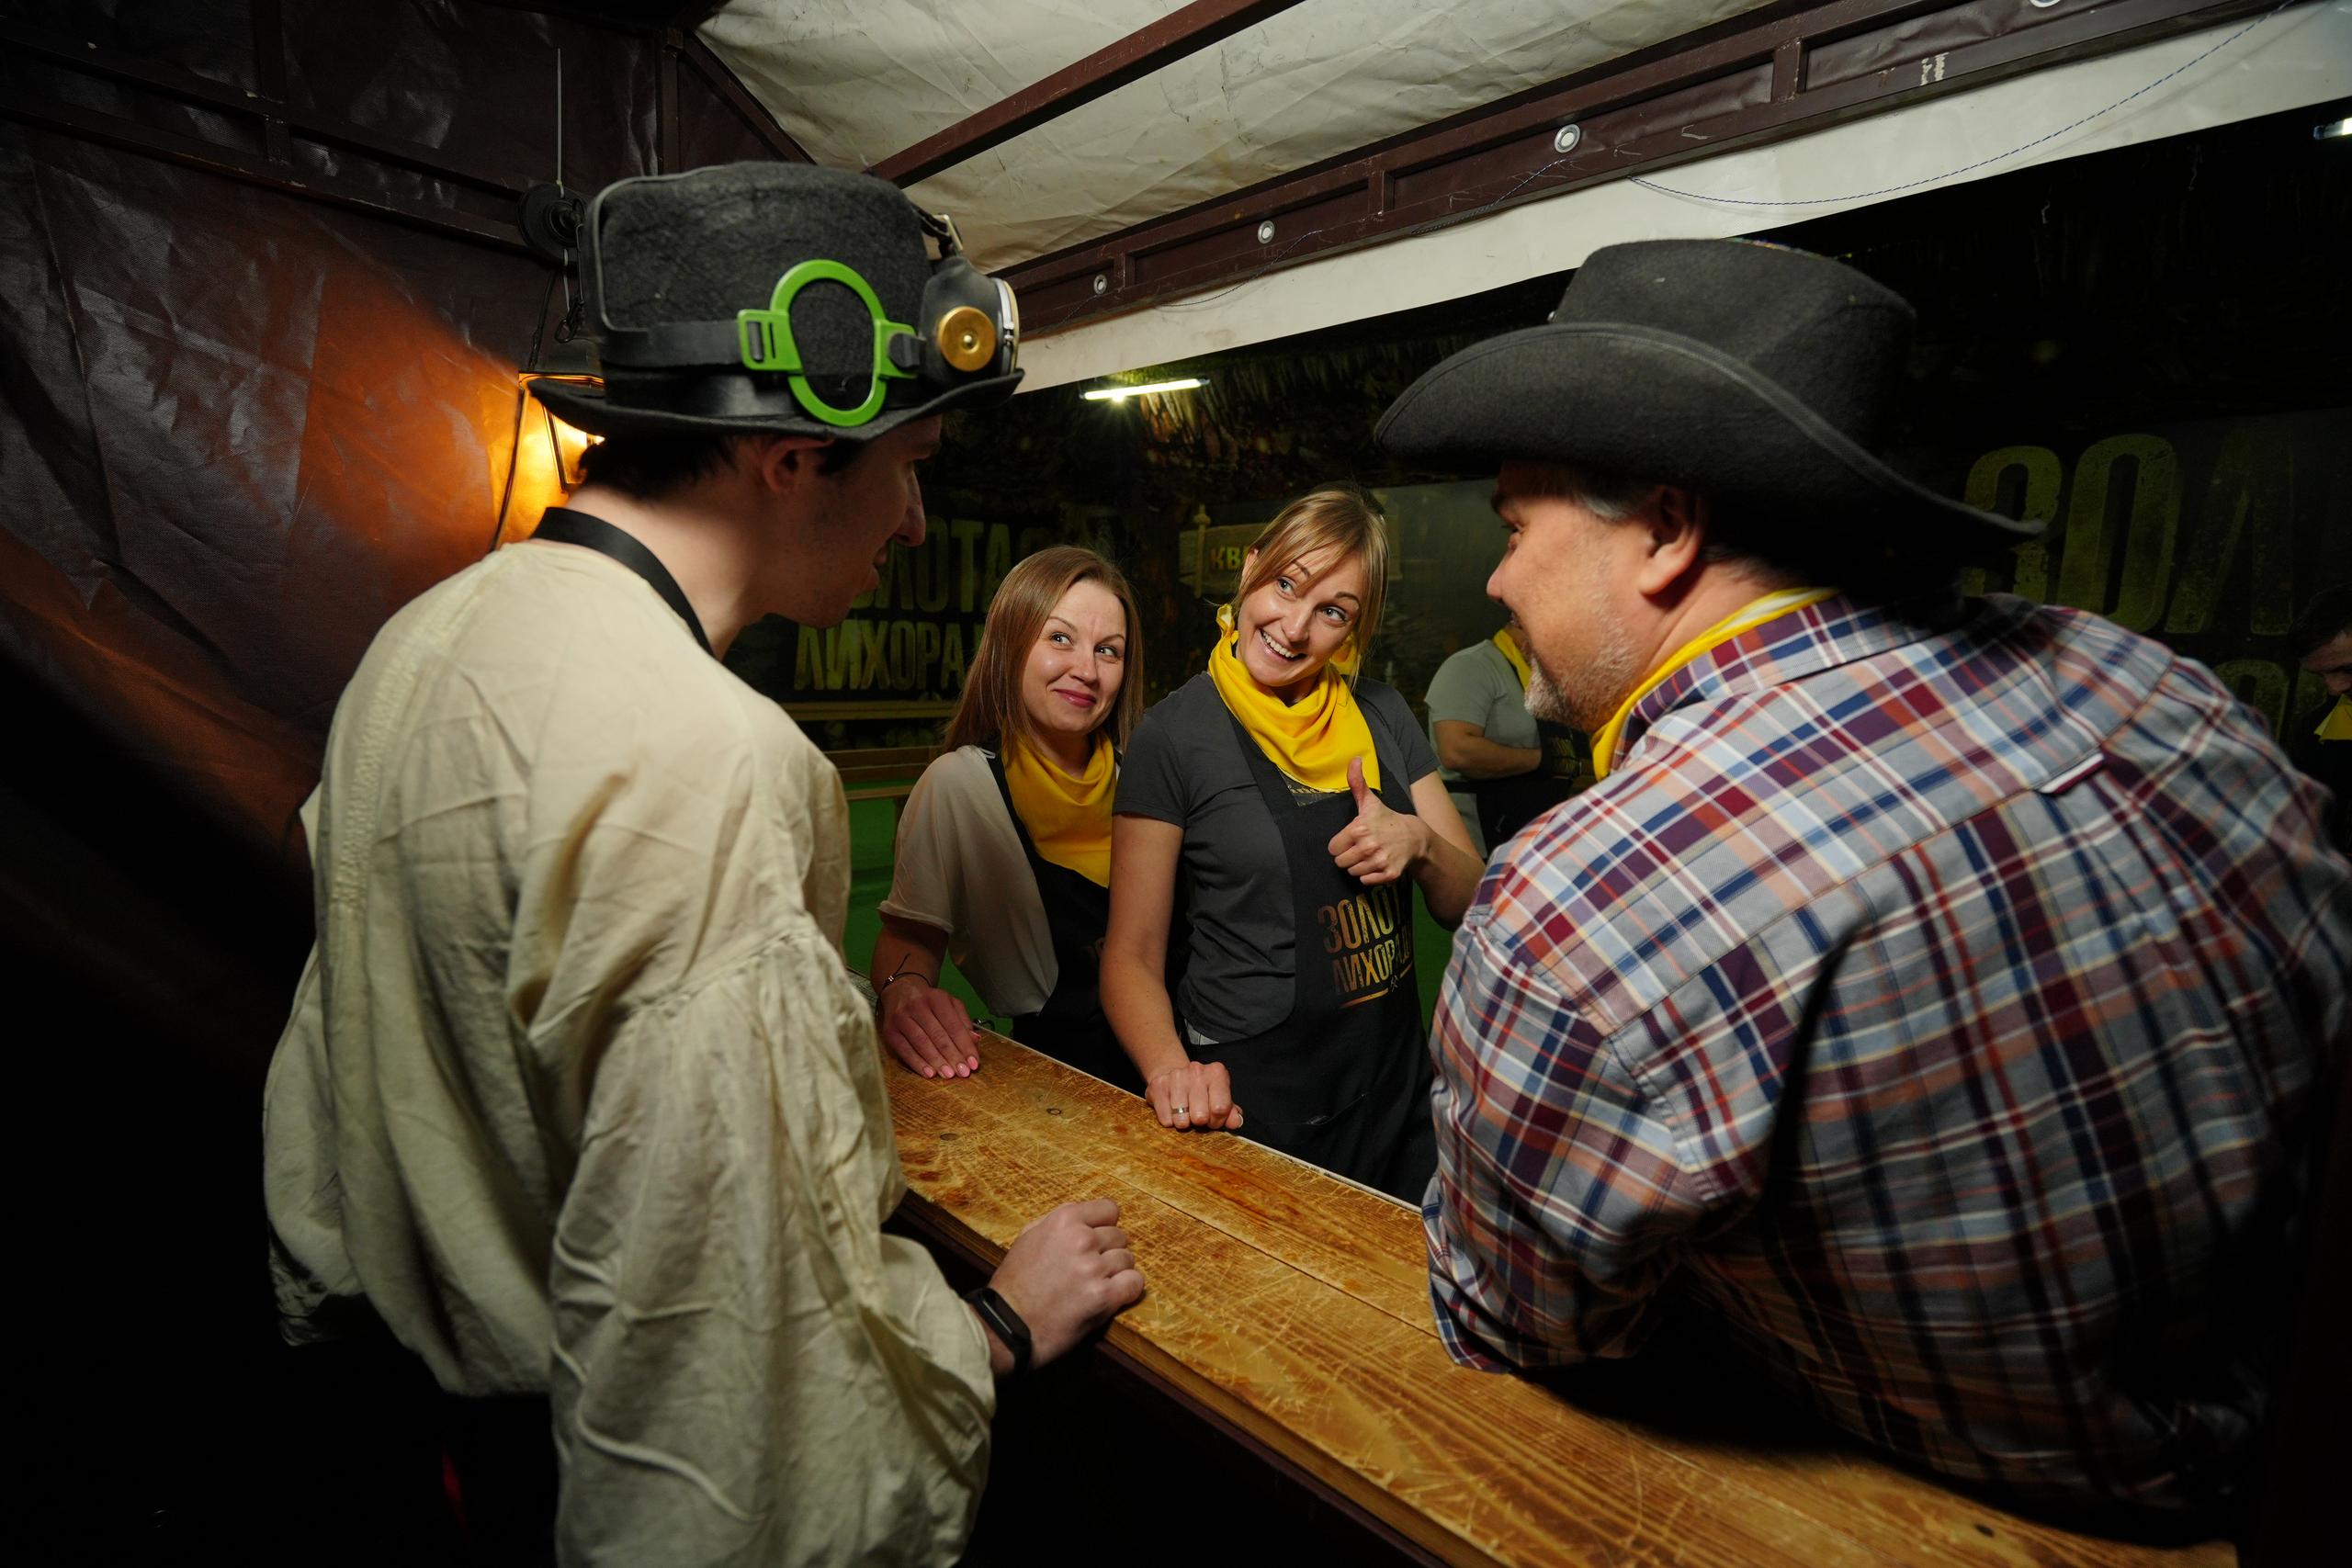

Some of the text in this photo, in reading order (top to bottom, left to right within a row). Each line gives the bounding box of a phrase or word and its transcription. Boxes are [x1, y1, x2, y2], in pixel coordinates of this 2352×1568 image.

[1210, 545, 1250, 571] КВ
[1961, 426, 2352, 634] ЗОЛ
[794, 618, 985, 691] ЛИХОРА
